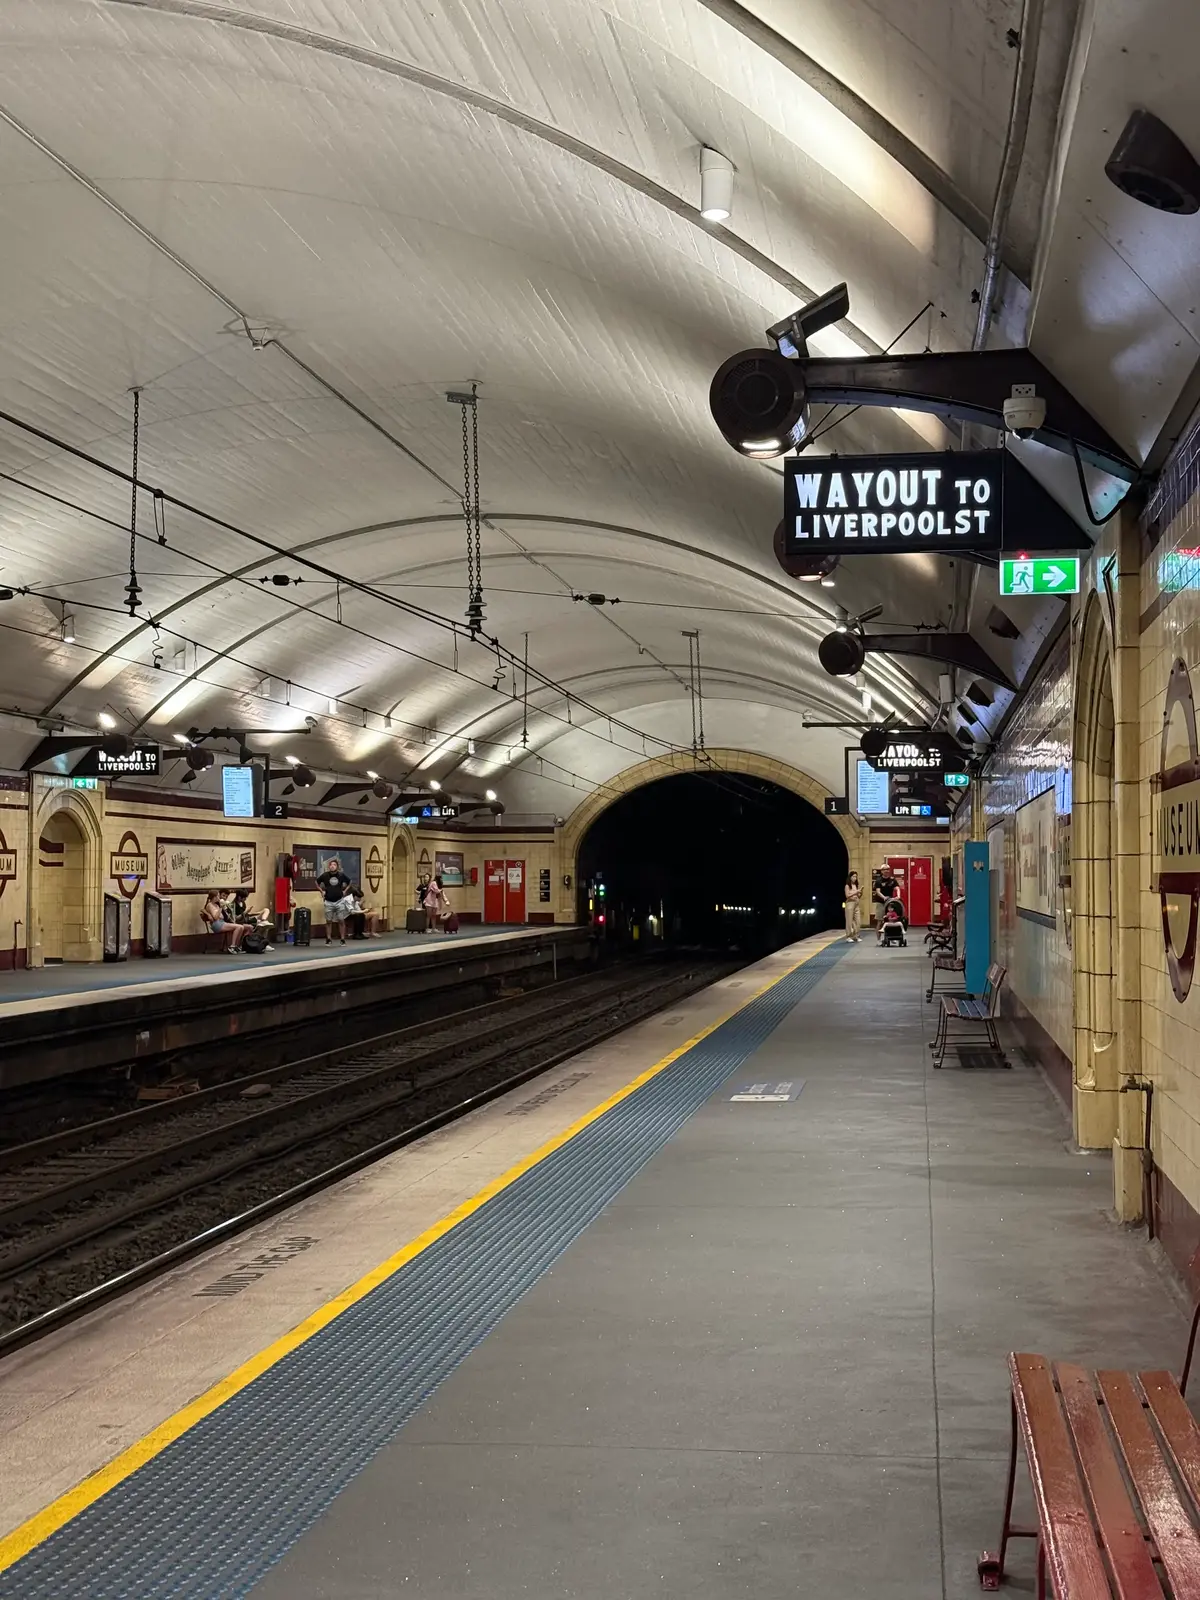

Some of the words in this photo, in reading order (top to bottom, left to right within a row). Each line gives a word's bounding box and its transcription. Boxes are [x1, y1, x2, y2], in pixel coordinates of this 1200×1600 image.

[954, 478, 991, 504] TO
[145, 753, 157, 762] TO
[275, 805, 283, 816] 2
[442, 805, 455, 816] Lift
[830, 801, 837, 812] 1
[895, 805, 910, 814] Lift
[115, 860, 145, 872] MUSEUM
[191, 1272, 265, 1297] MIND
[235, 1253, 298, 1271] THE
[269, 1236, 321, 1253] GAP
